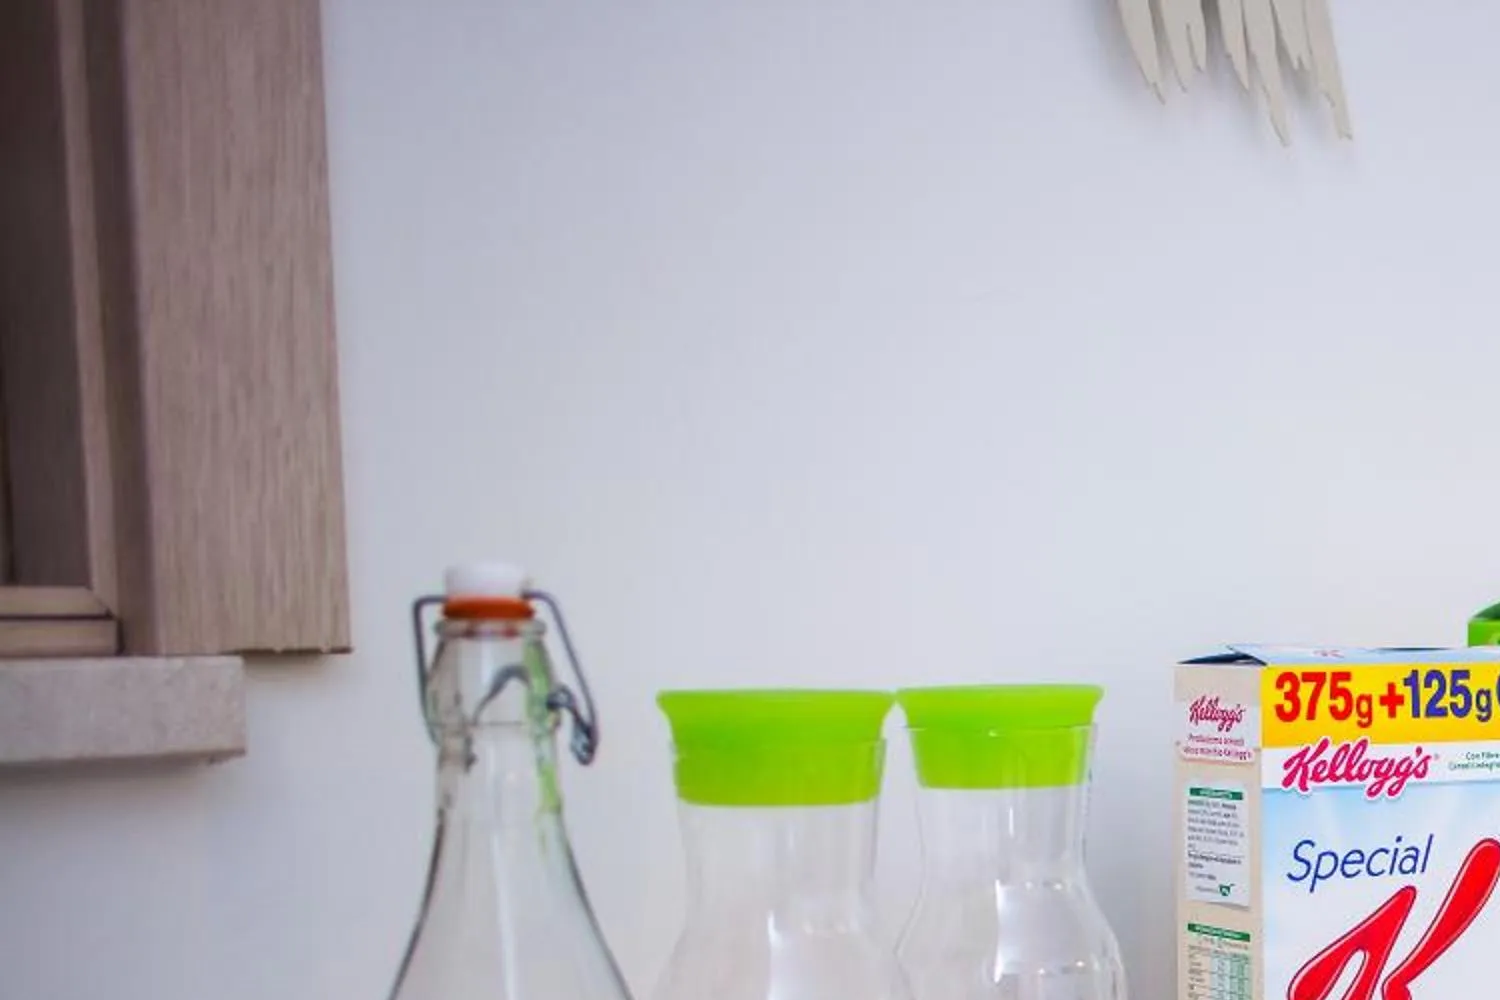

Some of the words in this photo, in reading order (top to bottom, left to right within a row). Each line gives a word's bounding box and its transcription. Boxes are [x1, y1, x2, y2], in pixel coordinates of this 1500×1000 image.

[1188, 695, 1245, 732] Kellogg's
[1282, 737, 1433, 798] Kellogg's
[1287, 834, 1435, 893] Special
